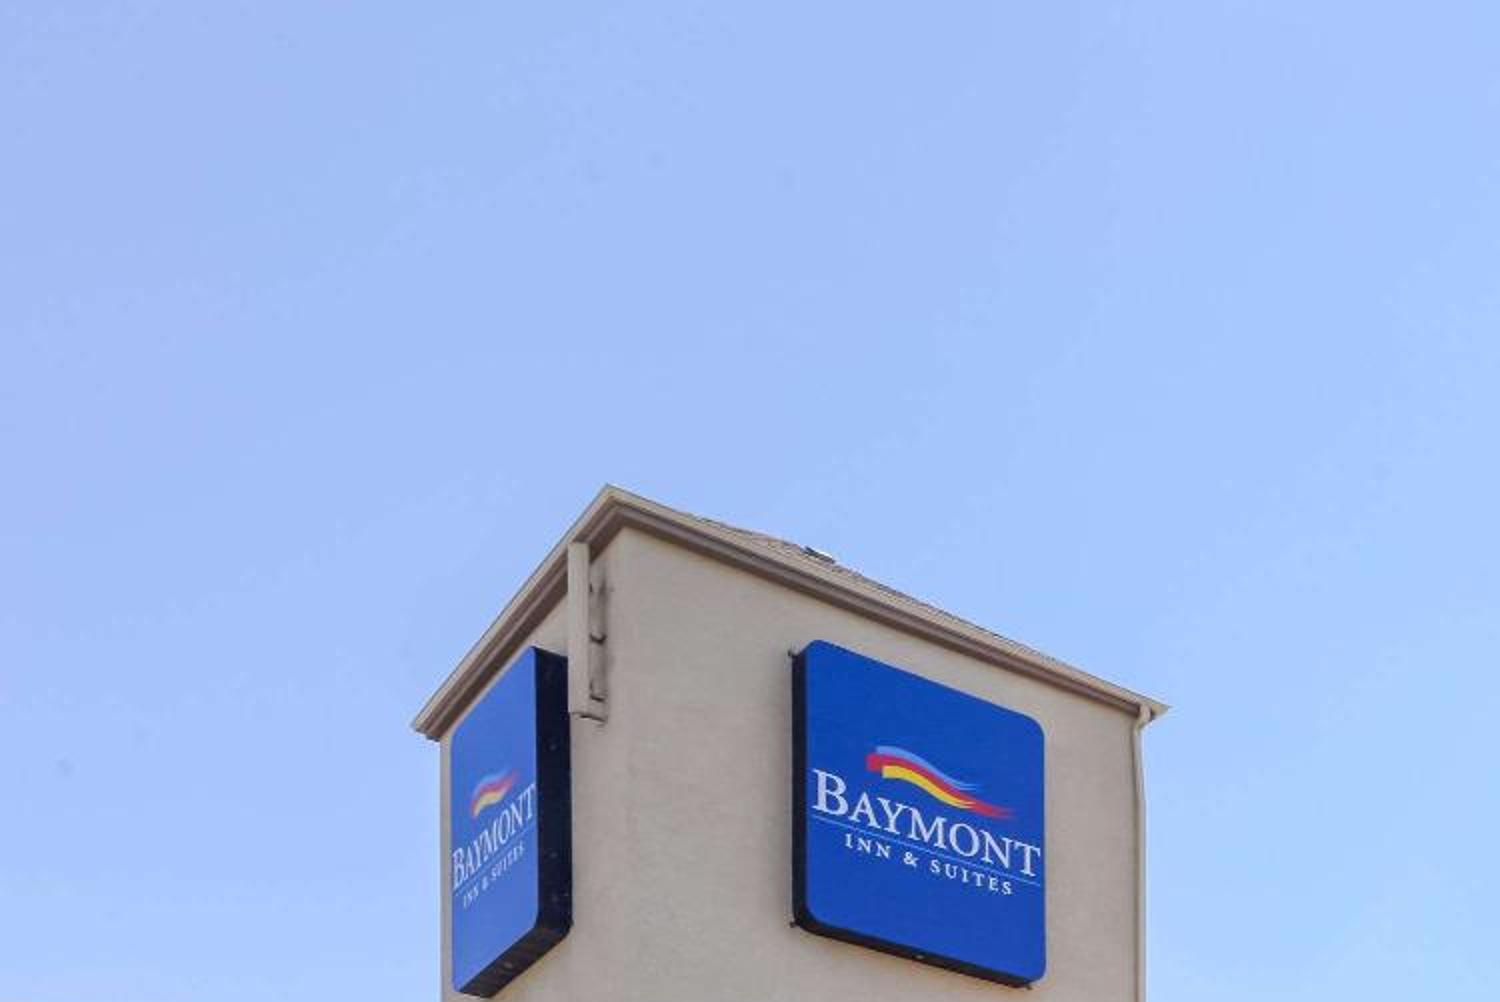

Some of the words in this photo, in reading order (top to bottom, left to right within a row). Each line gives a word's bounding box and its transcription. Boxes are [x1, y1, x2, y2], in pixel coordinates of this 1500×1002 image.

[453, 783, 537, 890] BAYMONT
[812, 769, 1041, 877] BAYMONT
[845, 833, 891, 859] INN
[903, 851, 919, 867] &
[930, 859, 1013, 896] SUITES
